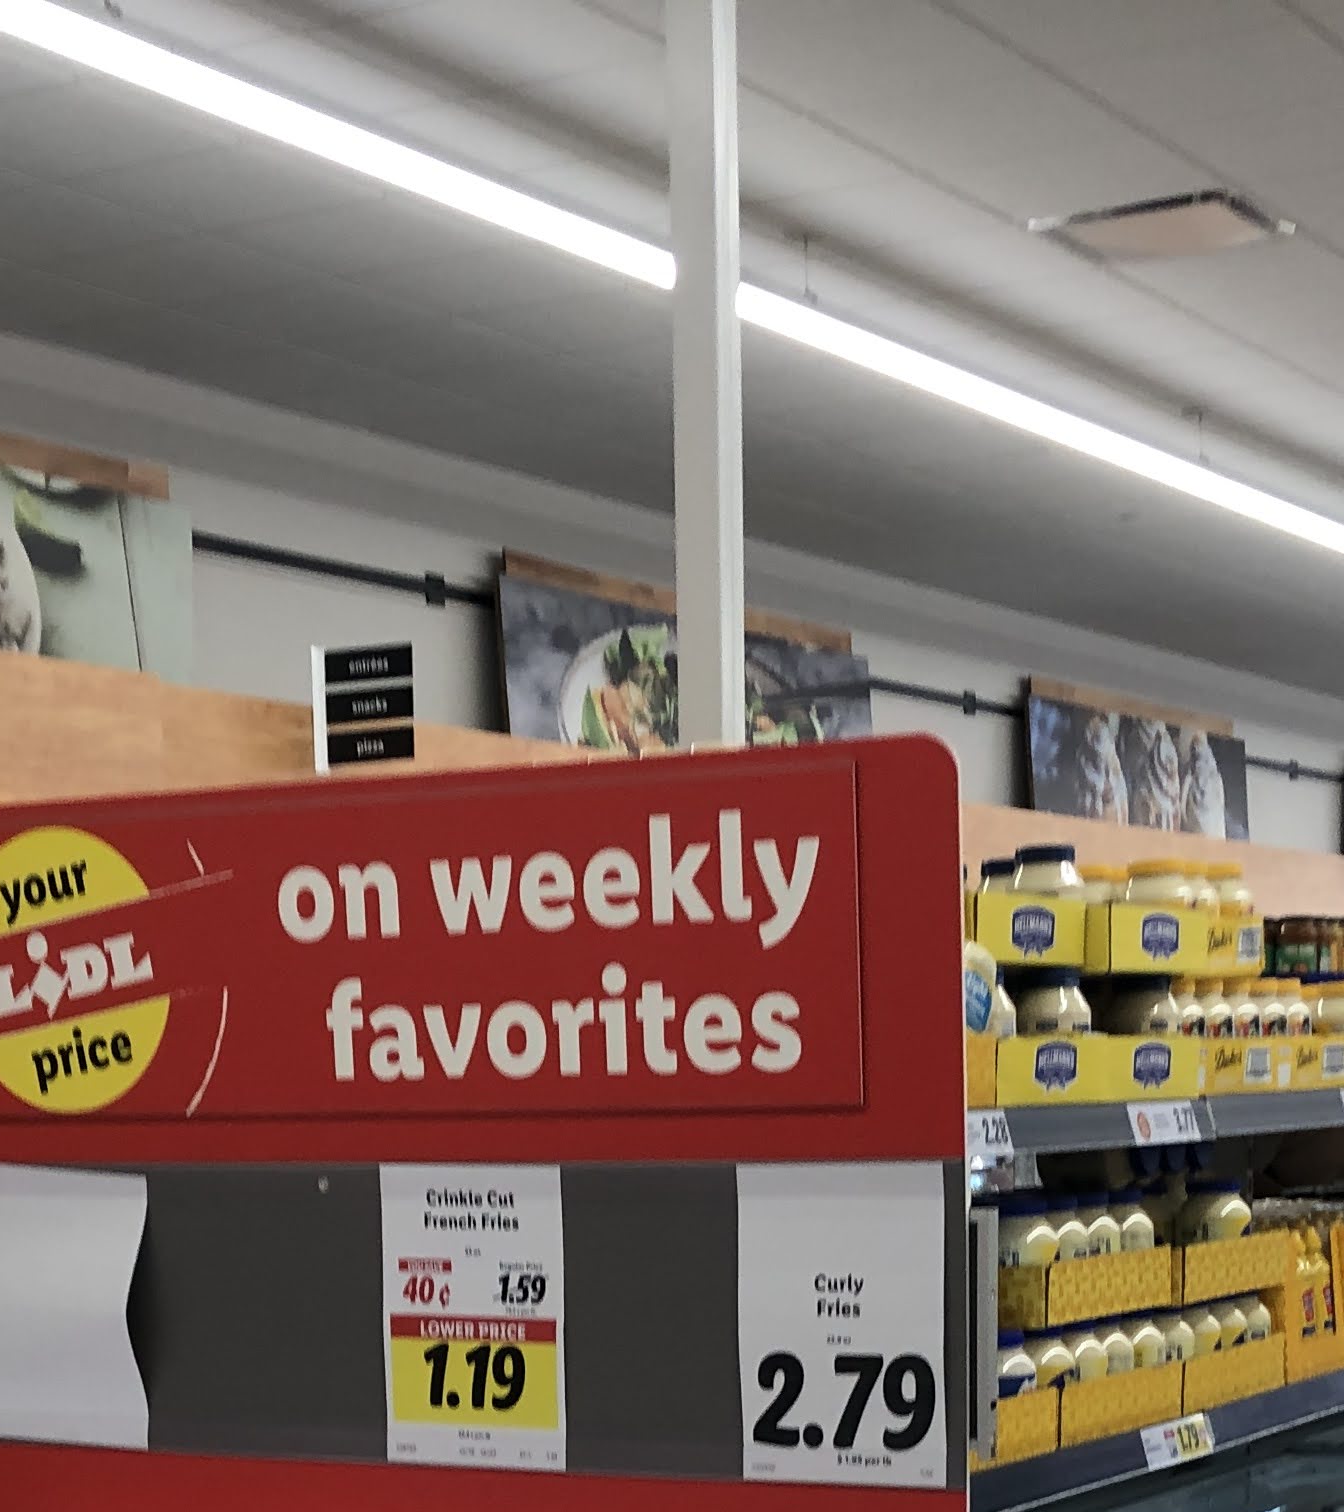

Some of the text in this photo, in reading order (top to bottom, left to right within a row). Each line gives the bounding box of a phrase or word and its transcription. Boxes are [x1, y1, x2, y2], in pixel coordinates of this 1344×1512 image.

[277, 808, 821, 951] on weekly
[327, 963, 803, 1083] favorites
[30, 1027, 134, 1095] price
[426, 1187, 516, 1209] Crinkle Cut
[423, 1211, 520, 1232] French Fries
[498, 1273, 547, 1305] 1.59
[814, 1272, 864, 1296] Curly
[817, 1297, 861, 1318] Fries
[420, 1319, 526, 1342] LOWER PRICE
[423, 1342, 527, 1411] 1.19
[752, 1351, 937, 1452] 2.79
